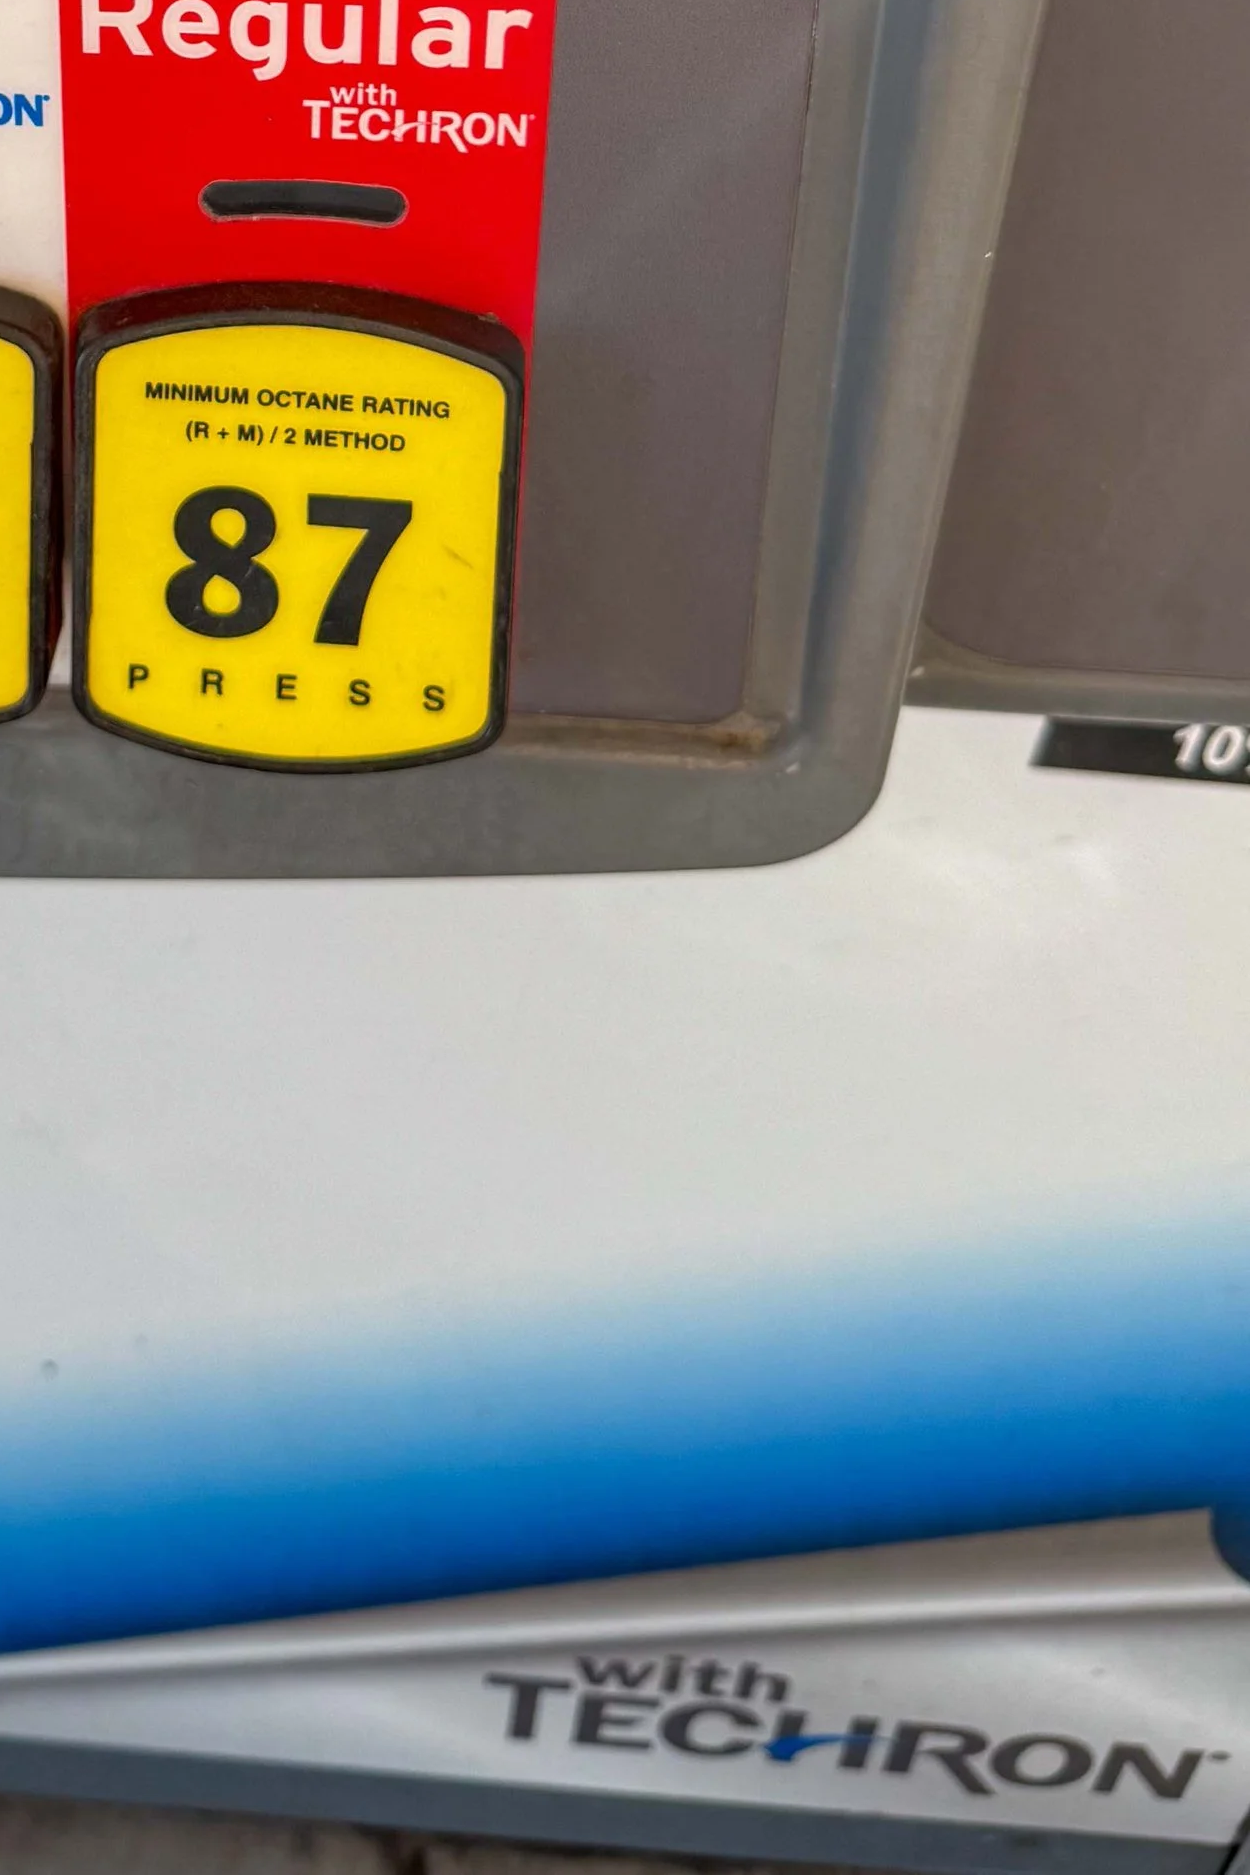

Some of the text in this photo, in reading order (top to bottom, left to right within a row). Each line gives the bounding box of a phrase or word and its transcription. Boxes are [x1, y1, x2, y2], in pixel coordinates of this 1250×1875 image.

[329, 82, 398, 107] with
[145, 381, 450, 419] MINIMUM OCTANE RATING
[304, 428, 406, 452] METHOD
[164, 485, 413, 647] 87
[1173, 724, 1250, 774] 10
[574, 1652, 792, 1706] with
